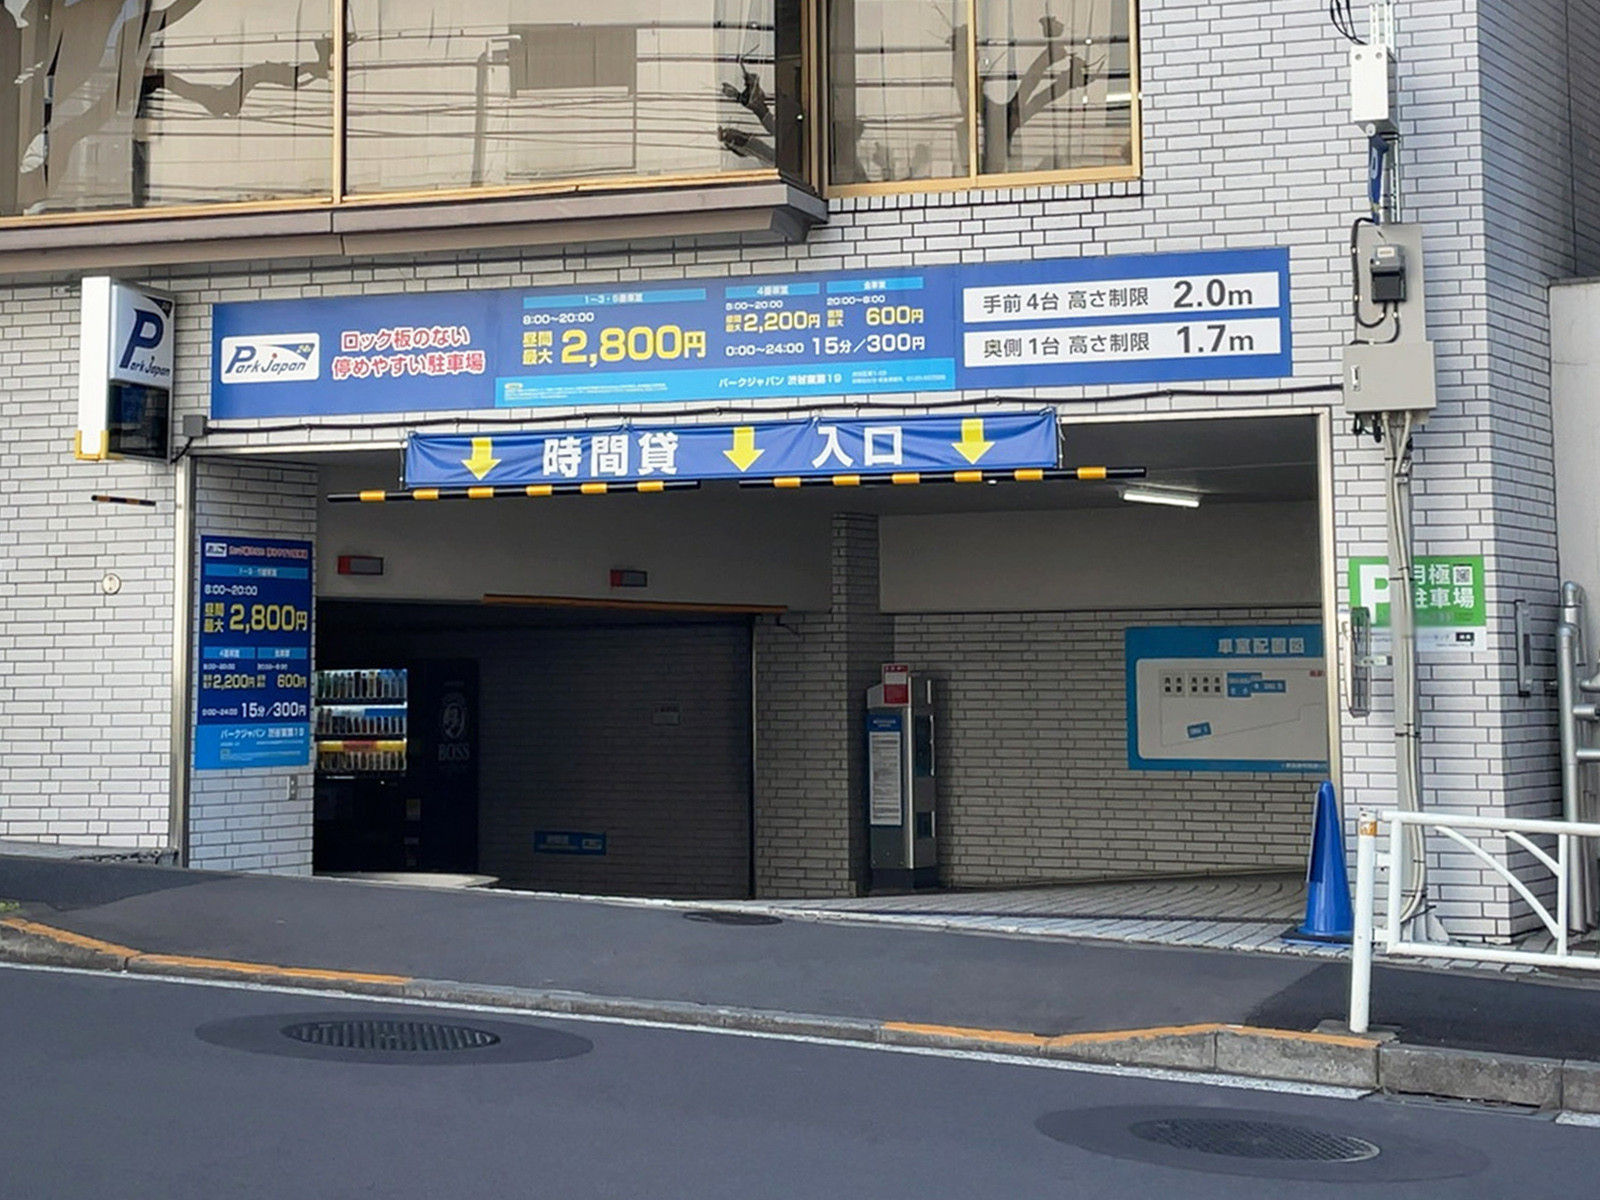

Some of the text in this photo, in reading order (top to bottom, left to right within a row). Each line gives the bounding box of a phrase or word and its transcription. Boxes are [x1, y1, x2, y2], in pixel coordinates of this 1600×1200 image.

[983, 278, 1253, 314] 手前4台 高さ制限 2.0m
[743, 310, 820, 333] 2,200円
[866, 306, 924, 326] 600円
[342, 327, 471, 352] ロック板のない
[561, 325, 706, 368] 2,800円
[983, 324, 1254, 359] 奥側1台 高さ制限 1.7m
[225, 345, 306, 375] Park Japan
[332, 351, 486, 380] 停めやすい駐車場
[522, 349, 553, 365] 最大
[718, 376, 784, 388] パークジャパン
[542, 425, 902, 477] 時間貸 入口
[1359, 564, 1391, 624] P
[229, 603, 308, 634] 2,800円
